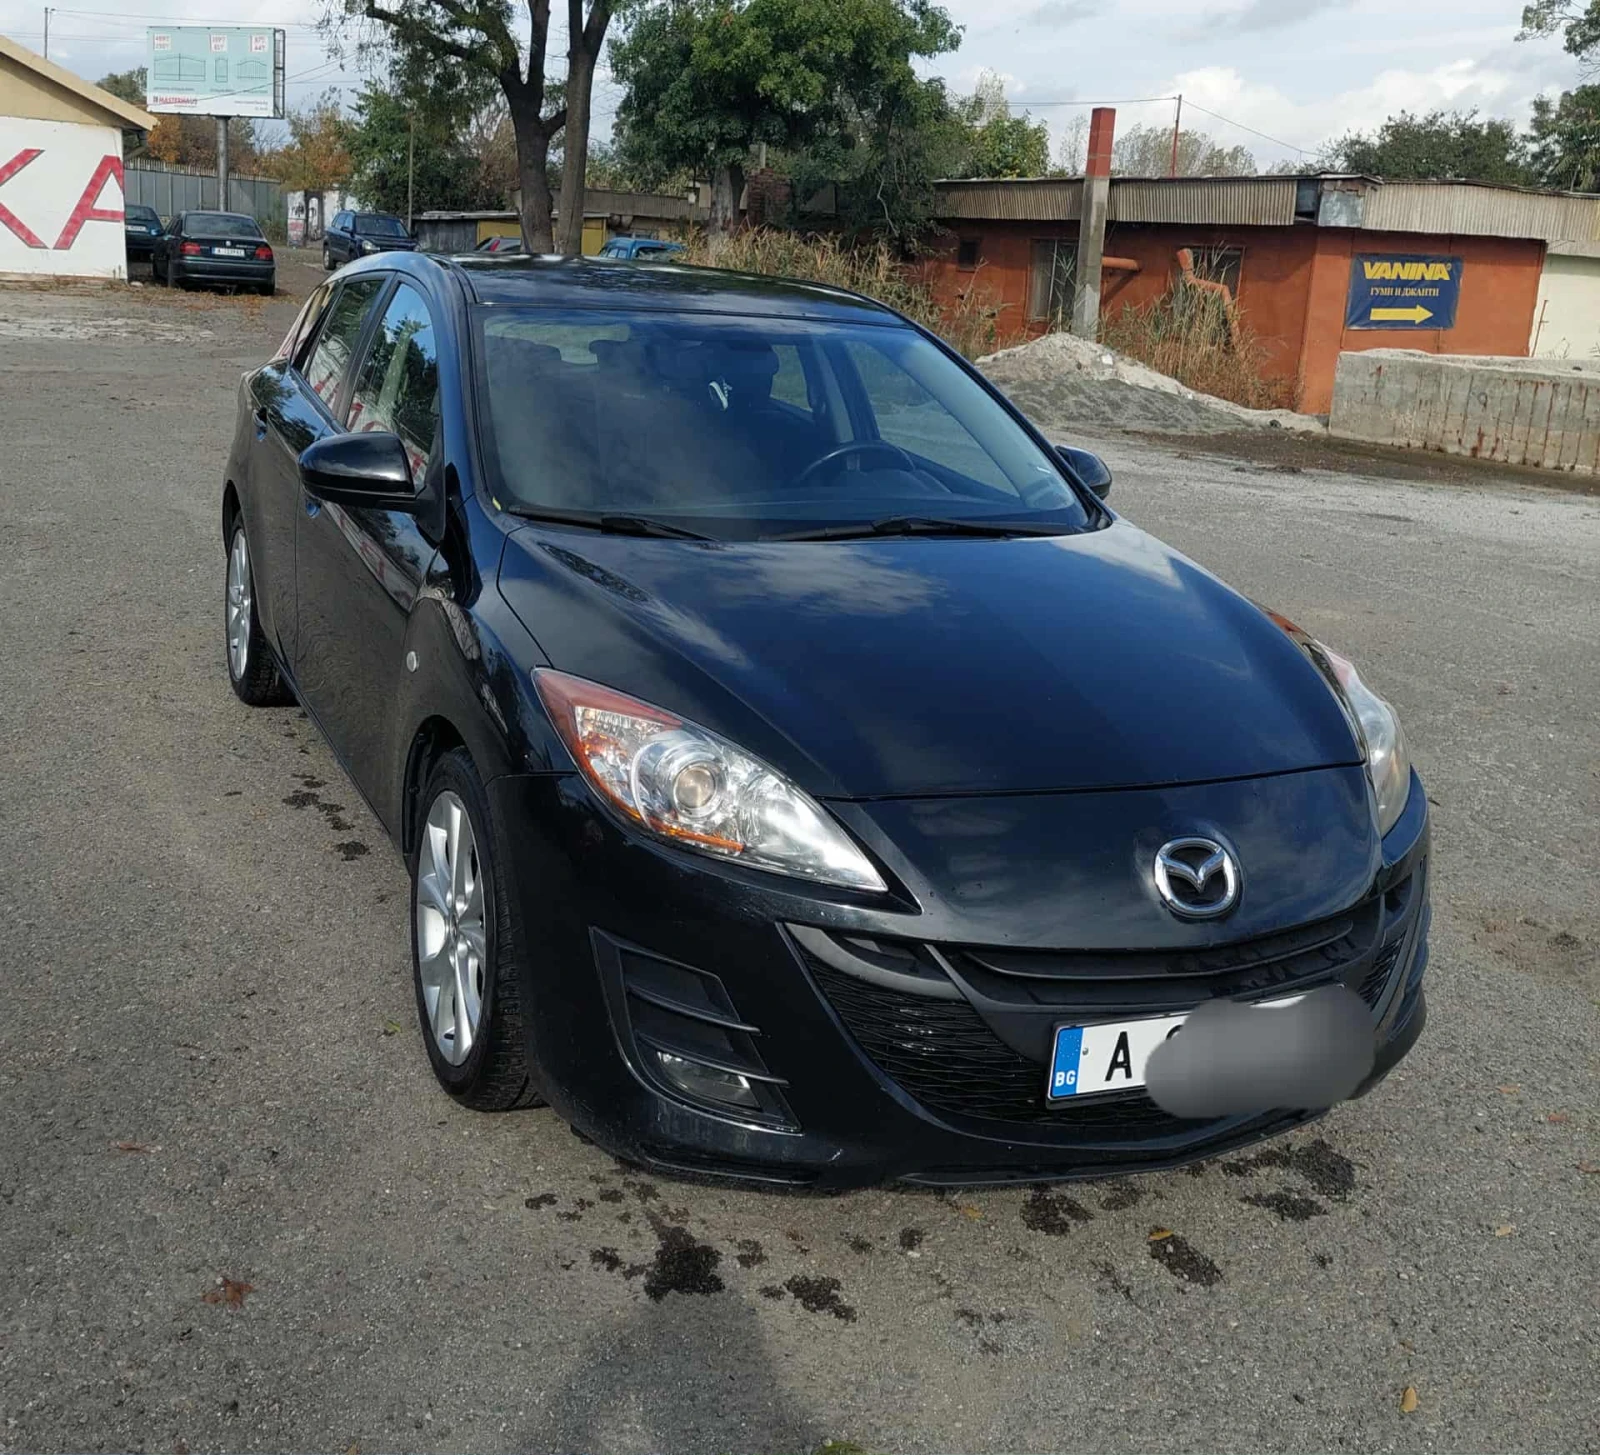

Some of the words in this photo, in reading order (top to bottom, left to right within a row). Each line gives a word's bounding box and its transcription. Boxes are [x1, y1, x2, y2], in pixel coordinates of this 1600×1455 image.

[1363, 262, 1450, 280] VANINA
[1370, 287, 1393, 296] ГУМИ
[1395, 287, 1401, 296] И
[1402, 287, 1439, 296] ДЖАНТИ
[1054, 1069, 1077, 1087] BG
